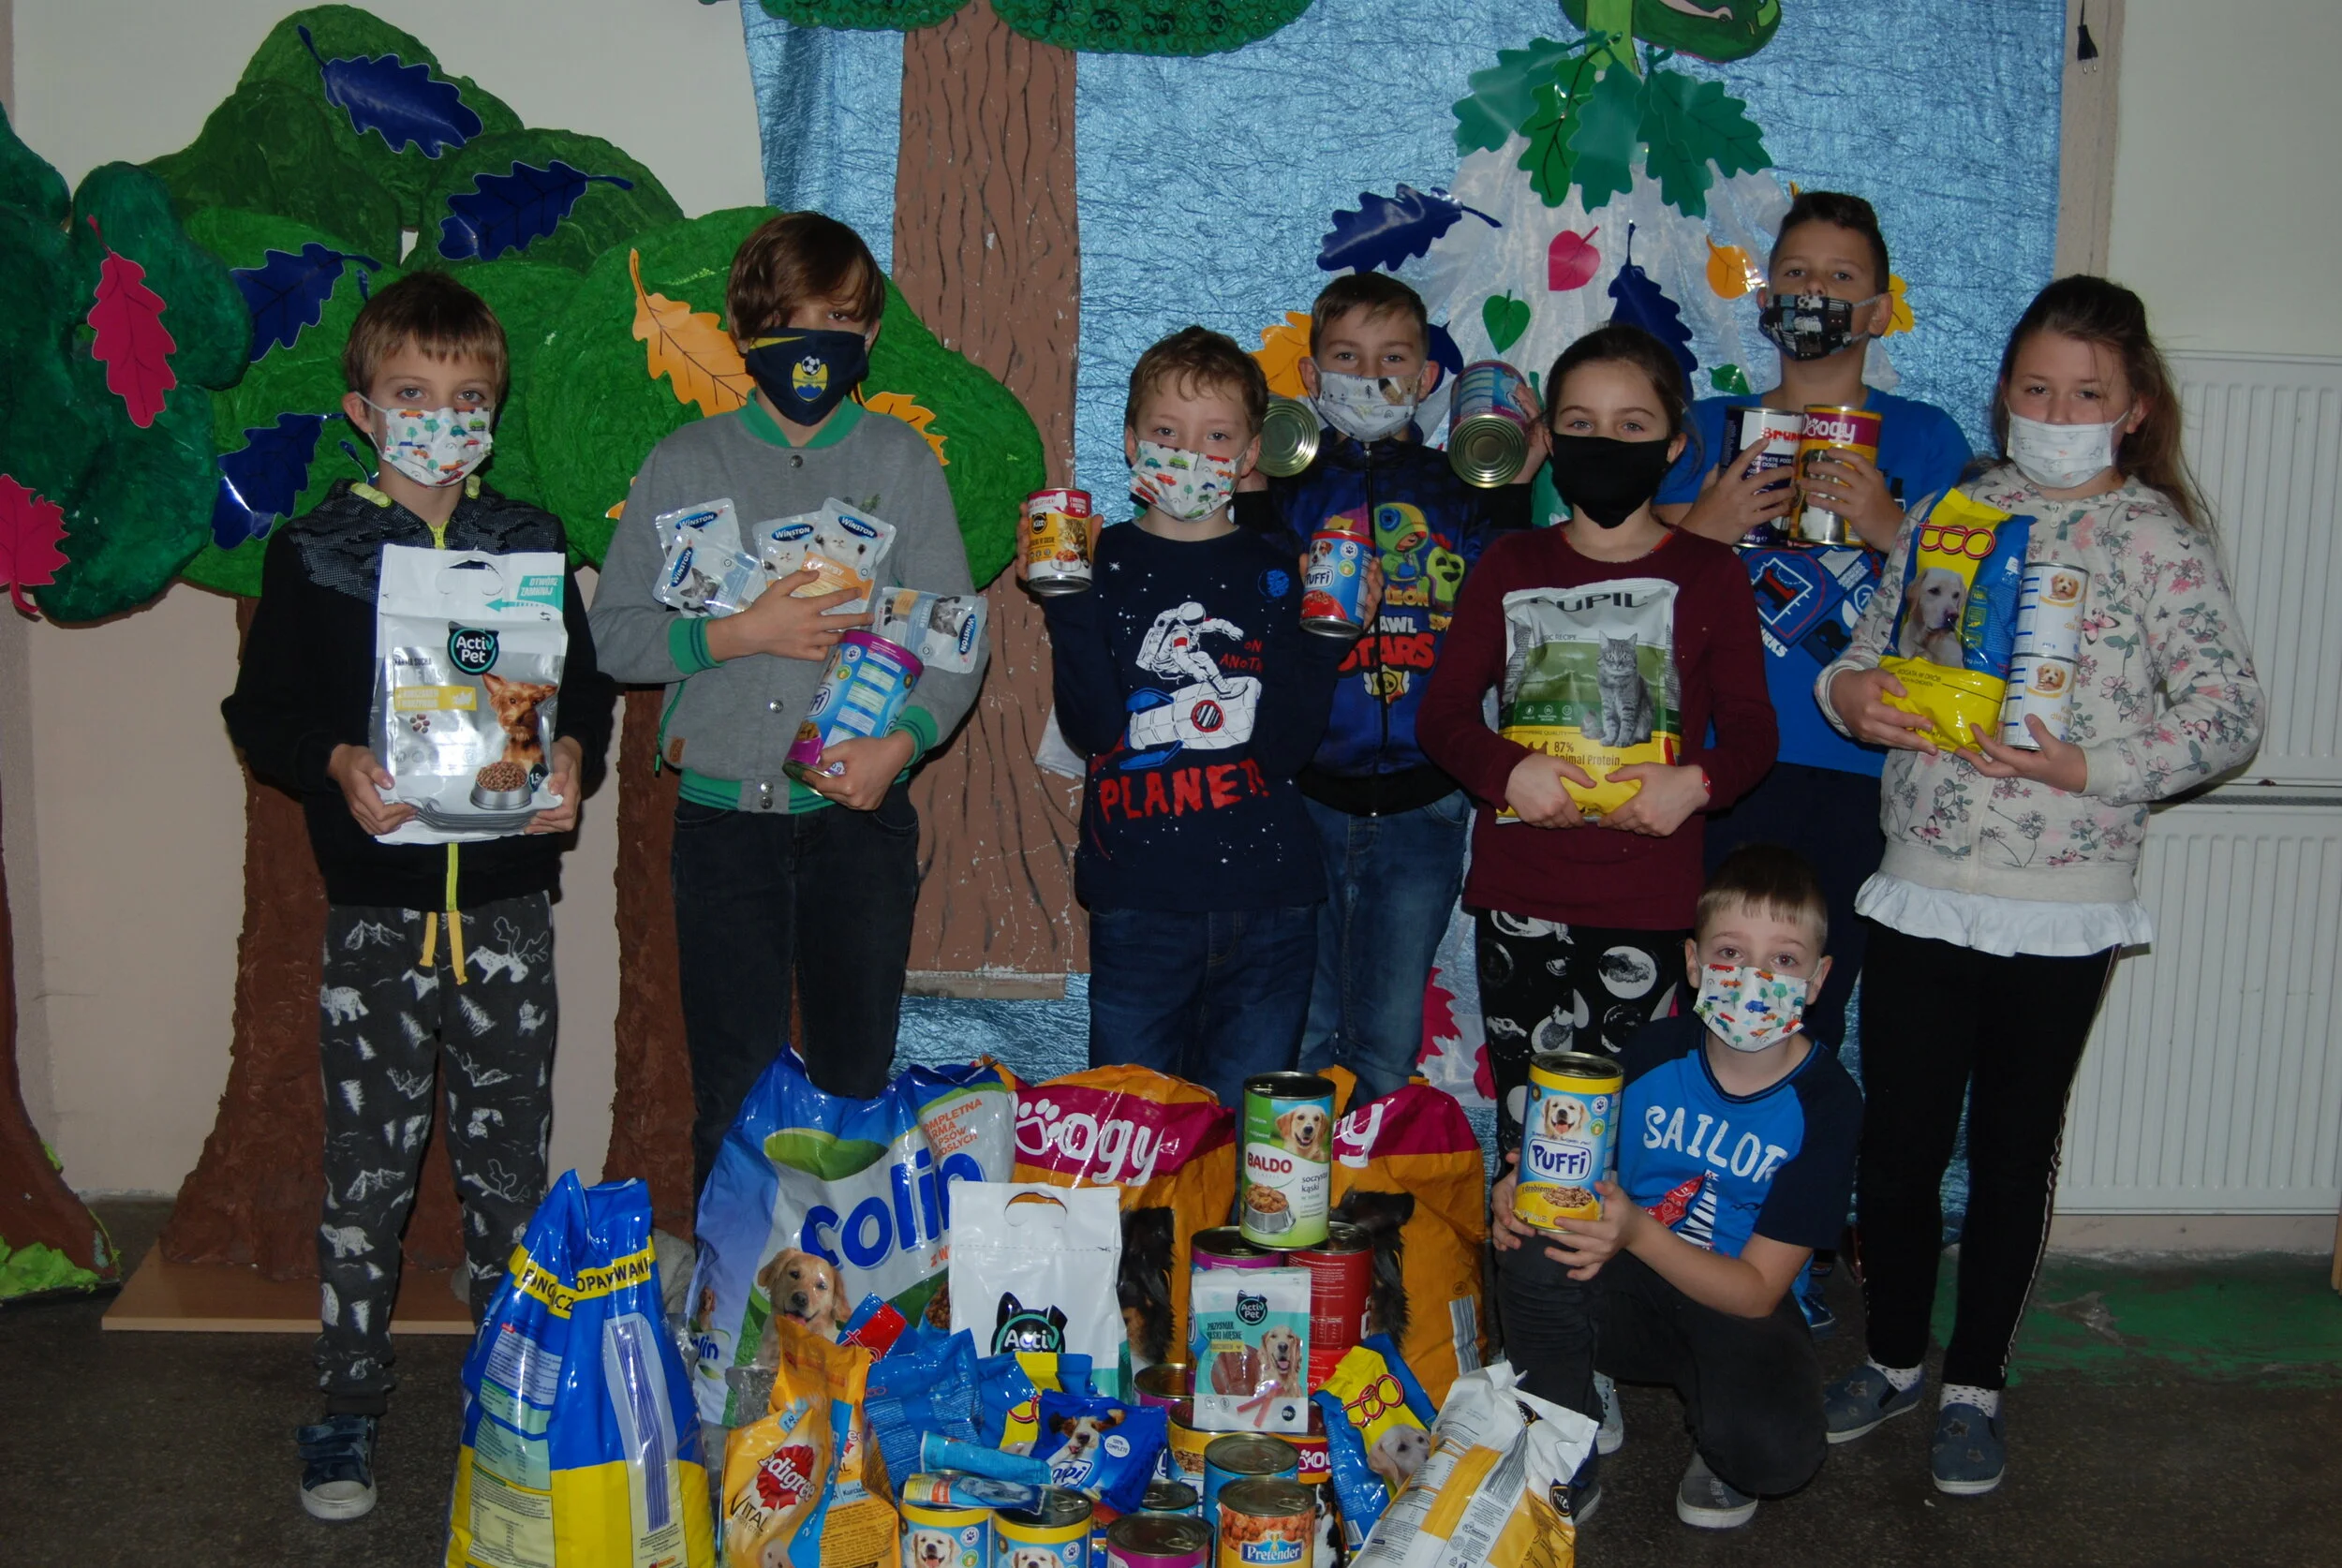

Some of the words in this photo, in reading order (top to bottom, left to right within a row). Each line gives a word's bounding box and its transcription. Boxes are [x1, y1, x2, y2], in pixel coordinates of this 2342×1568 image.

[461, 650, 486, 664] Pet
[1553, 740, 1575, 754] 87%
[1247, 1151, 1293, 1175] BALDO
[1301, 1183, 1321, 1195] kąski
[1244, 1311, 1260, 1320] Pet
[1106, 1443, 1129, 1455] COMPLETE
[1246, 1545, 1301, 1564] Pretender
